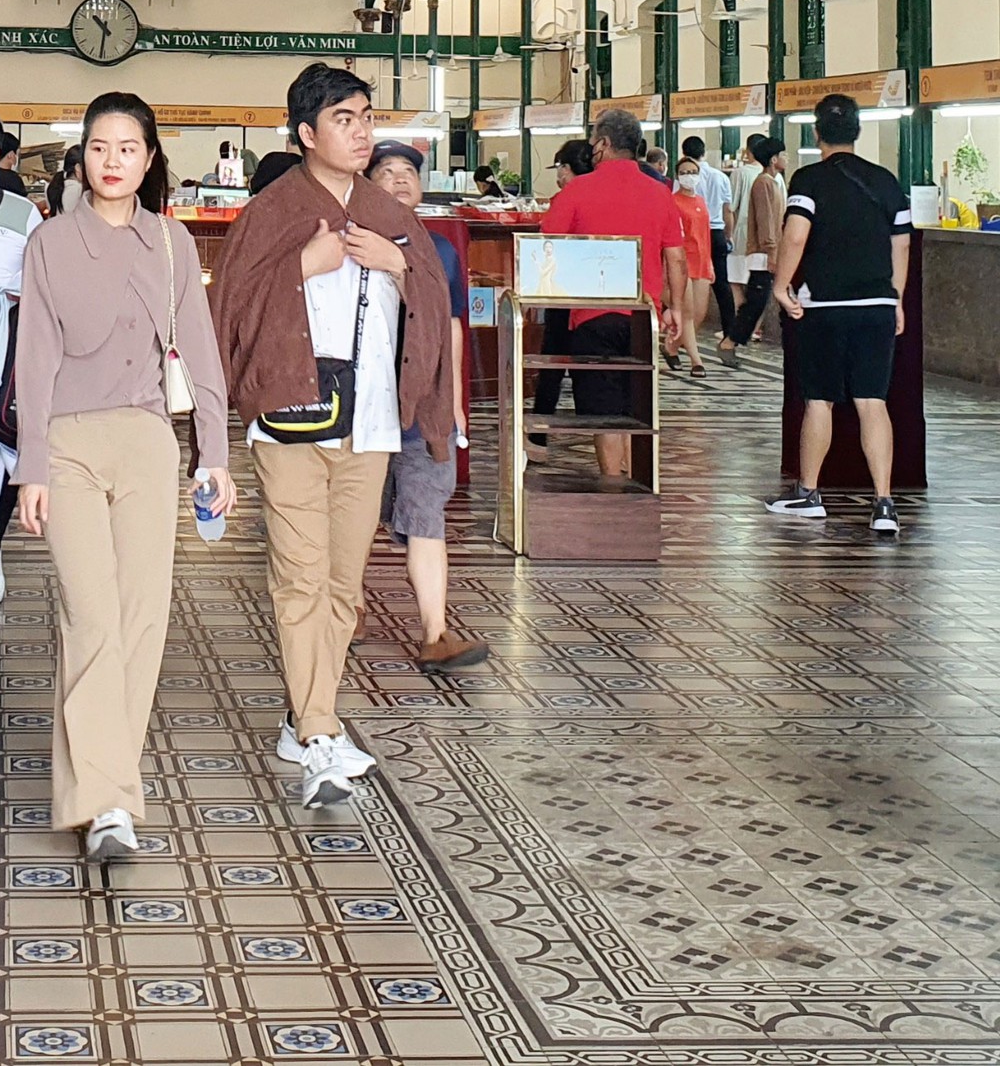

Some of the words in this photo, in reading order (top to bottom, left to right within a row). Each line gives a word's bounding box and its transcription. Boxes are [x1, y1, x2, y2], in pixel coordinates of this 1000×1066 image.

[28, 30, 59, 44] XÁC
[153, 34, 171, 45] AN
[173, 32, 210, 46] TOÀN
[220, 33, 252, 48] TIỆN
[255, 35, 278, 48] LỢI
[289, 35, 313, 48] VĂN
[320, 37, 356, 49] MINH
